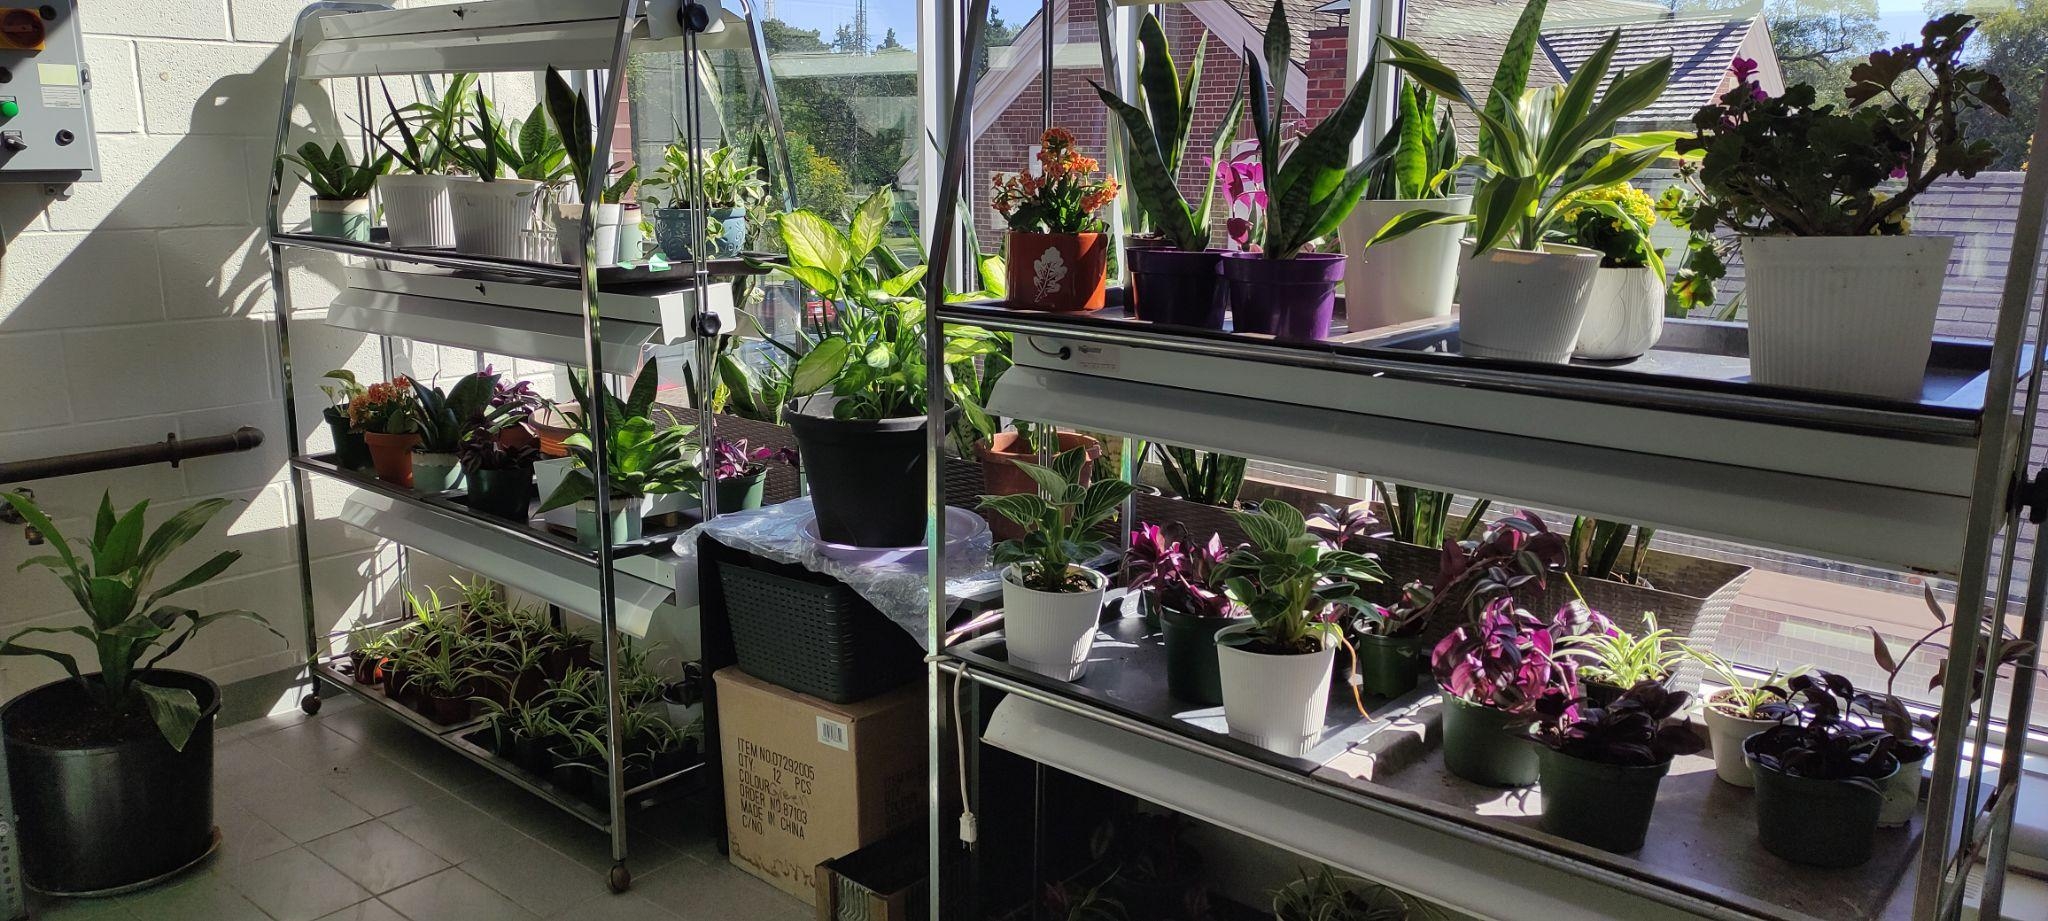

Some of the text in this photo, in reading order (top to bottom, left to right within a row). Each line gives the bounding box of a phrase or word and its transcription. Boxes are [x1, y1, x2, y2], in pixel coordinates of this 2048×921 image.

[738, 737, 758, 757] ITEM
[739, 769, 770, 792] COLOUR
[773, 767, 782, 784] 12
[795, 776, 812, 794] PCS
[740, 784, 766, 807] ORDER
[741, 797, 805, 840] MADE IN CHINA
